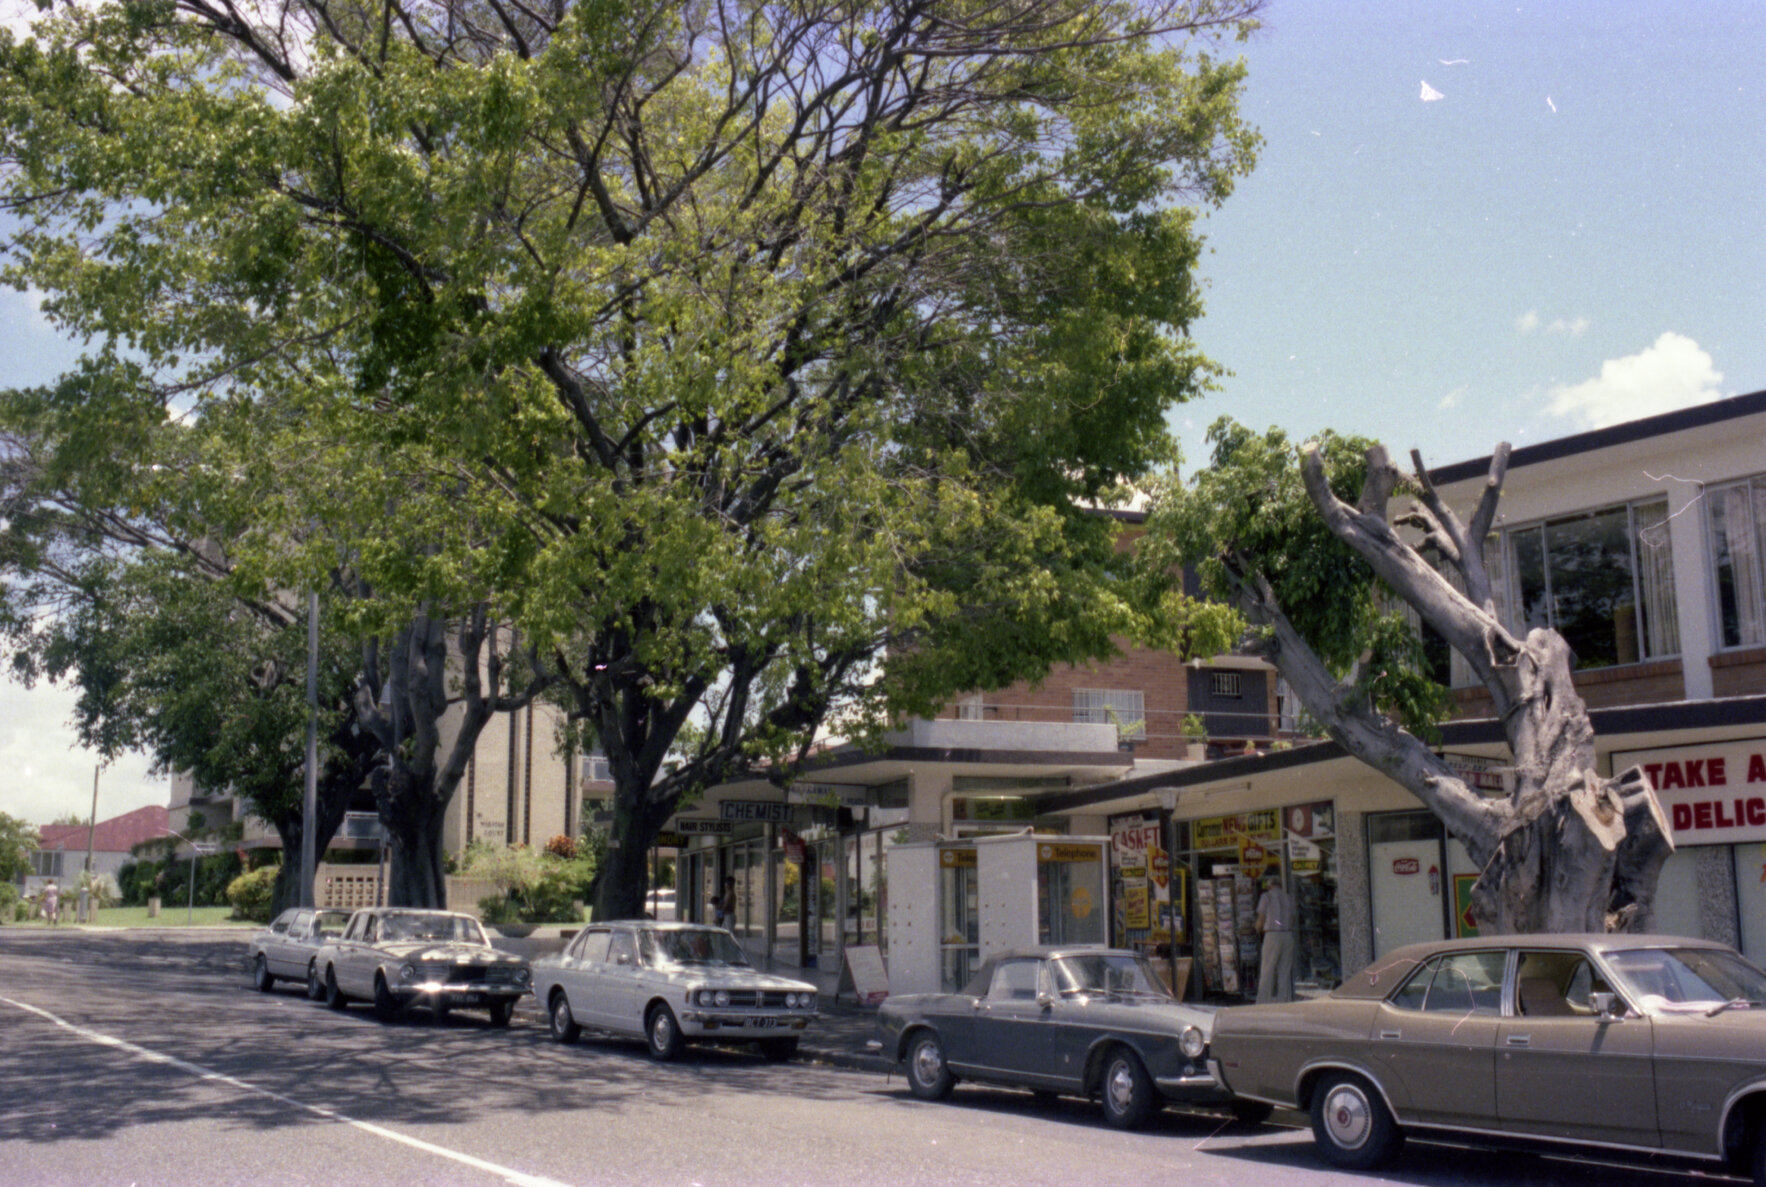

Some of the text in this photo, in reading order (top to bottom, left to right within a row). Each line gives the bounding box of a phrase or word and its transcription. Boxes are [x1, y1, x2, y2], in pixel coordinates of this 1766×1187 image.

[1645, 758, 1726, 790] TAKE
[724, 803, 790, 820] CHEMIST
[680, 822, 732, 833] HAIR STYLISTS
[1222, 815, 1246, 835] NEWS
[1248, 811, 1275, 831] GIFTS
[1112, 826, 1159, 852] CASKET
[1055, 849, 1097, 859] Telephone
